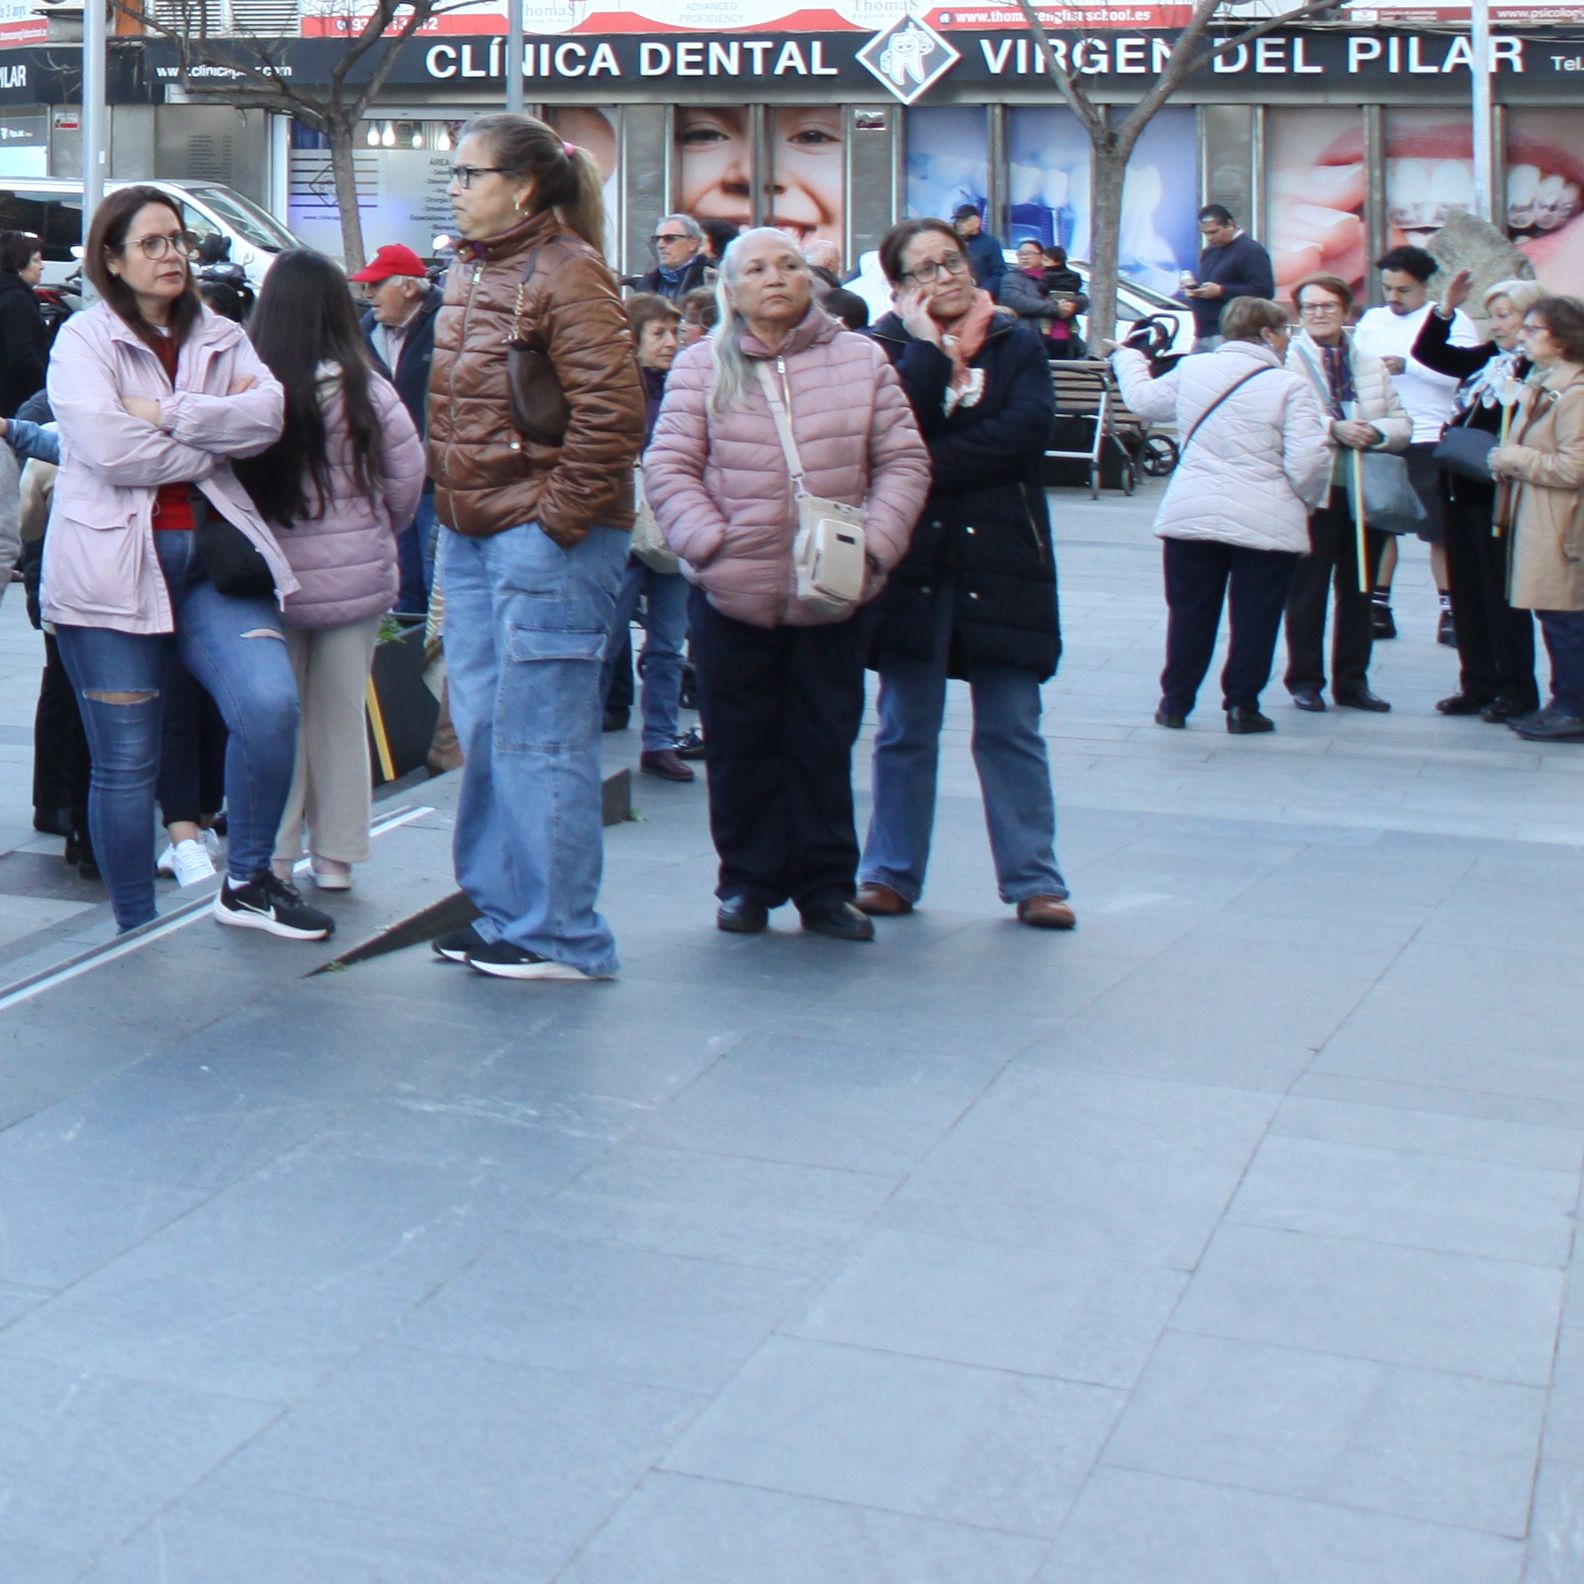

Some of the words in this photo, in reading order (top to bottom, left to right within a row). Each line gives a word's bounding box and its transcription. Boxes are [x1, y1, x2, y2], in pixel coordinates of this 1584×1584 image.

[526, 4, 575, 17] homaS
[426, 36, 621, 78] CLÍNICA
[639, 40, 839, 77] DENTAL
[979, 36, 1182, 75] VIRGEN
[1212, 36, 1323, 75] DEL
[1347, 35, 1524, 74] PILAR
